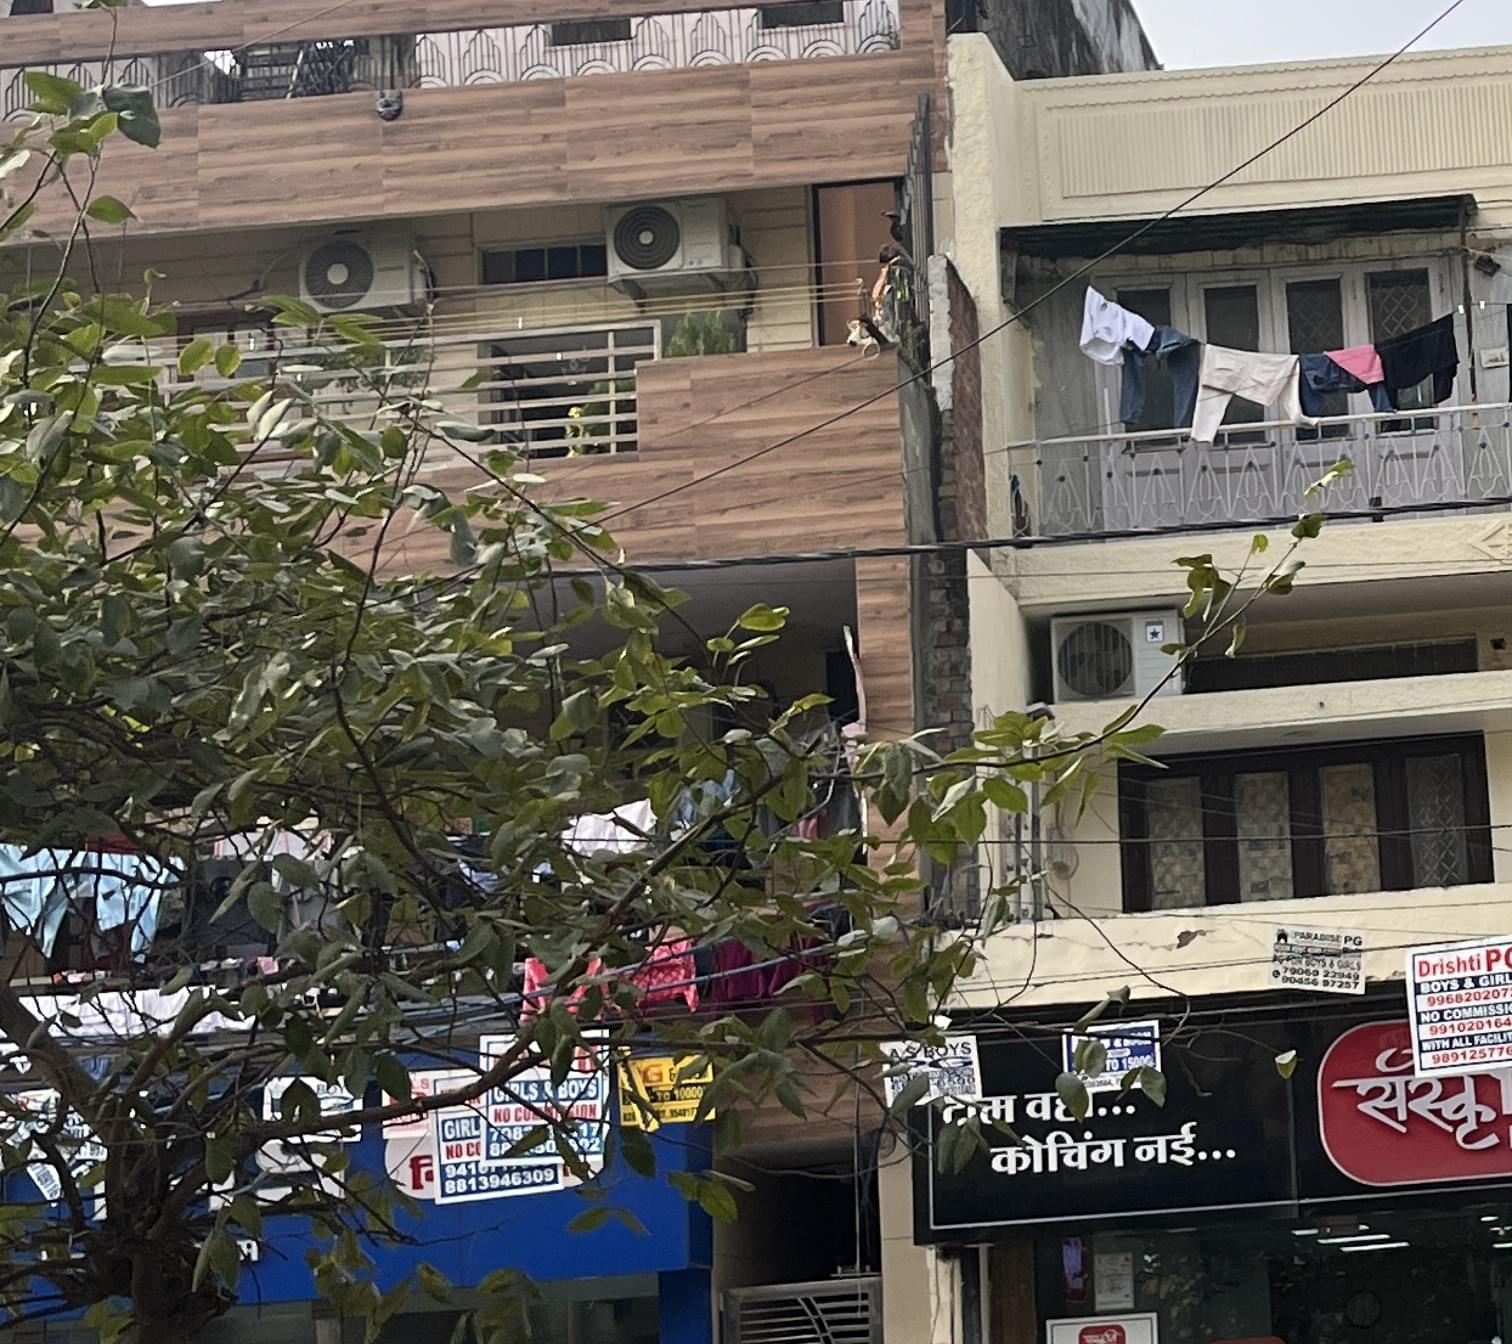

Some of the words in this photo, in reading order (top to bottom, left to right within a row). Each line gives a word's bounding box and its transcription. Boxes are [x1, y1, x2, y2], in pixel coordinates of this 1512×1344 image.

[1344, 935, 1363, 946] PG
[1418, 954, 1481, 977] Drishti
[1420, 979, 1459, 994] BOYS
[1463, 977, 1474, 989] &
[1420, 1011, 1440, 1023] NO
[1422, 1040, 1450, 1051] WITH
[1452, 1037, 1472, 1049] ALL
[557, 1076, 598, 1099] BOYS
[494, 1107, 511, 1123] NO
[444, 1117, 480, 1140] GIRL
[445, 1143, 463, 1160] NO
[990, 1130, 1127, 1175] कोचिंग
[445, 1168, 555, 1195] 8813946309
